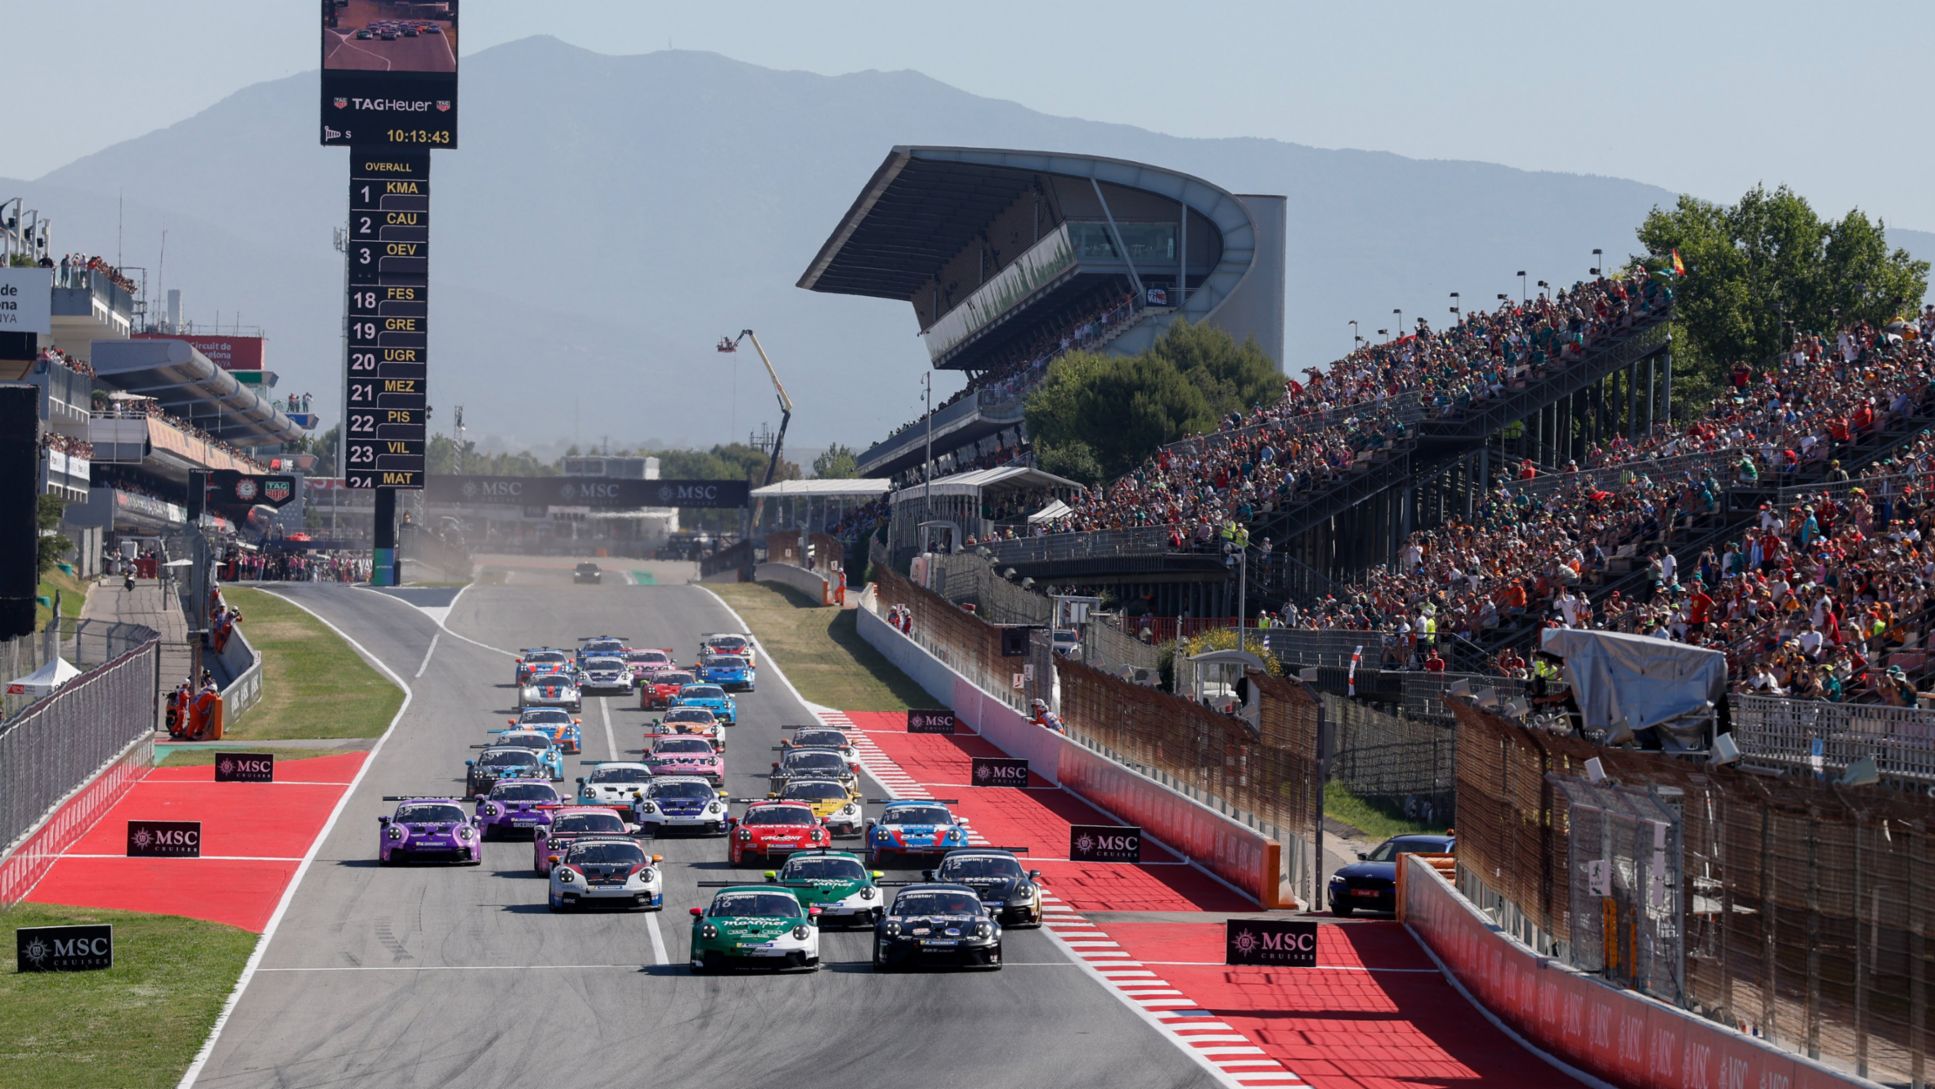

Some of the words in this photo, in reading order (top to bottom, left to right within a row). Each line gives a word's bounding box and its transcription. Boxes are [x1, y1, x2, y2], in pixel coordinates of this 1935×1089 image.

[386, 130, 450, 144] 10:13:43
[365, 162, 412, 172] OVERALL
[361, 186, 370, 203] 1
[386, 182, 418, 194] KMA
[360, 217, 371, 234] 2
[386, 212, 417, 225] CAU
[360, 248, 371, 264] 3
[386, 244, 416, 256] OEV
[0, 284, 18, 296] de
[0, 300, 18, 310] na
[354, 292, 376, 309] 18
[388, 288, 414, 300] FES
[353, 322, 376, 340] 19
[386, 319, 416, 330] GRE
[352, 354, 375, 370] 20
[384, 349, 416, 361] UGR
[351, 384, 372, 401] 21
[384, 380, 414, 392] MEZ
[350, 416, 374, 432] 22
[388, 411, 410, 423] PIS
[350, 446, 374, 462] 23
[388, 442, 410, 454] VIL
[383, 473, 412, 484] MAT
[482, 482, 522, 496] MSC
[580, 483, 620, 498] MSC
[677, 485, 718, 500] MSC
[926, 716, 953, 726] MSC
[237, 760, 271, 772] MSC
[993, 766, 1026, 778] MSC
[155, 830, 198, 846] MSC
[1098, 835, 1138, 850] MSC
[53, 937, 108, 957] MSC
[1262, 932, 1314, 952] MSC
[54, 958, 108, 966] CRUISES
